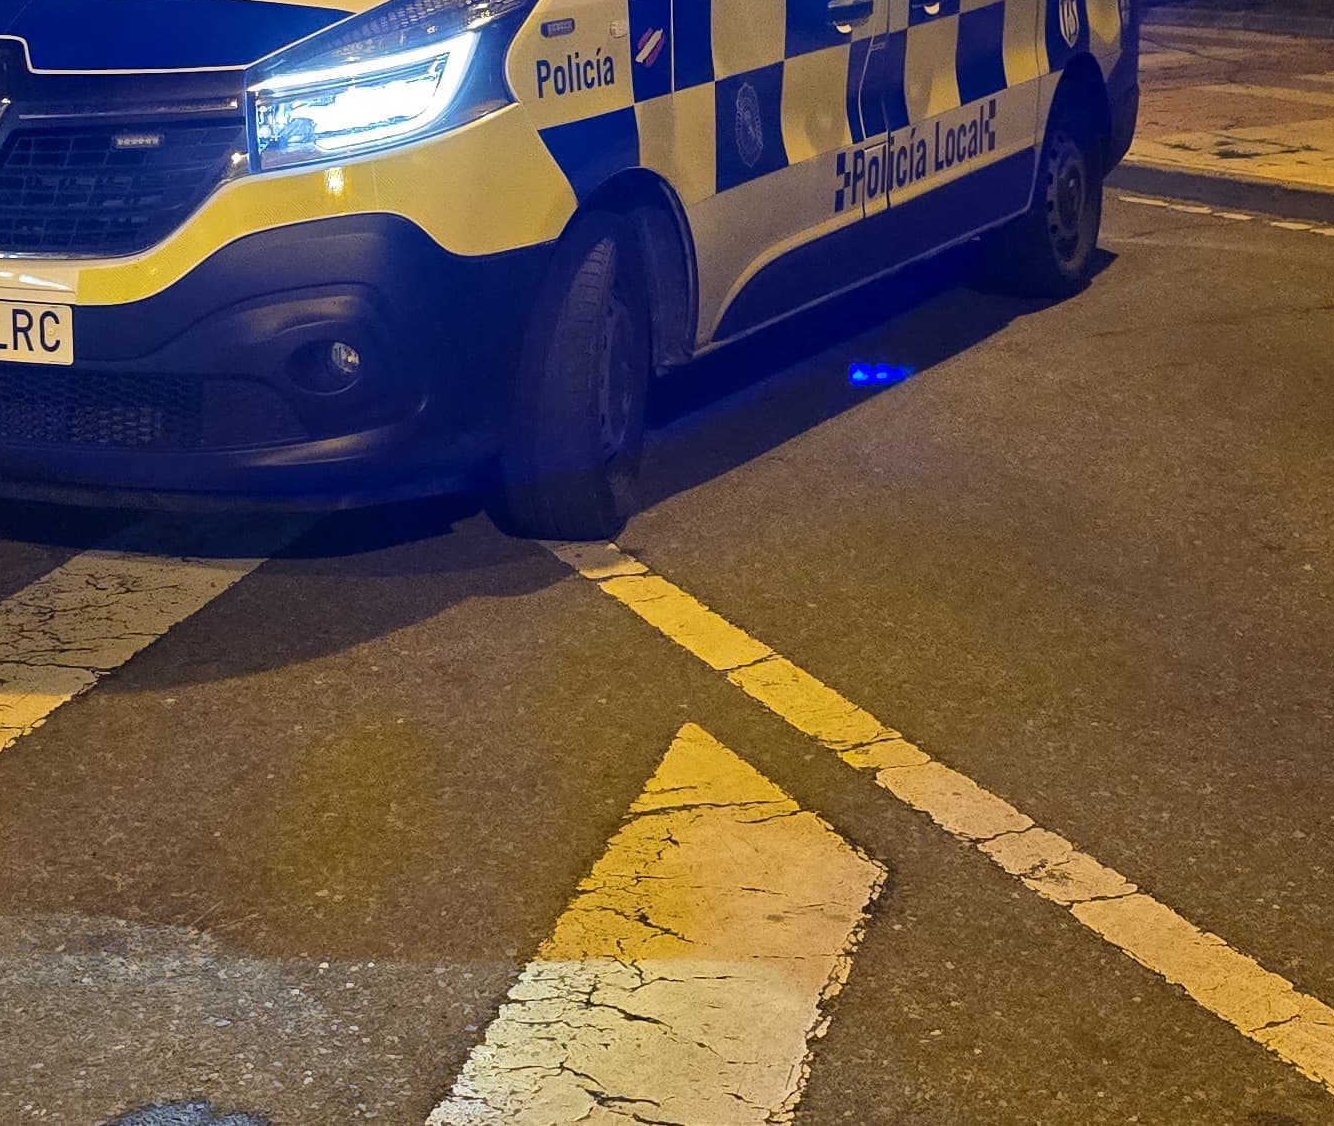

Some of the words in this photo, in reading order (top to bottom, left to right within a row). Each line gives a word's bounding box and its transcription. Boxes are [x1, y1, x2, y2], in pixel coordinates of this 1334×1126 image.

[536, 47, 615, 99] Policía
[851, 127, 927, 205] Policía
[934, 105, 984, 172] Local
